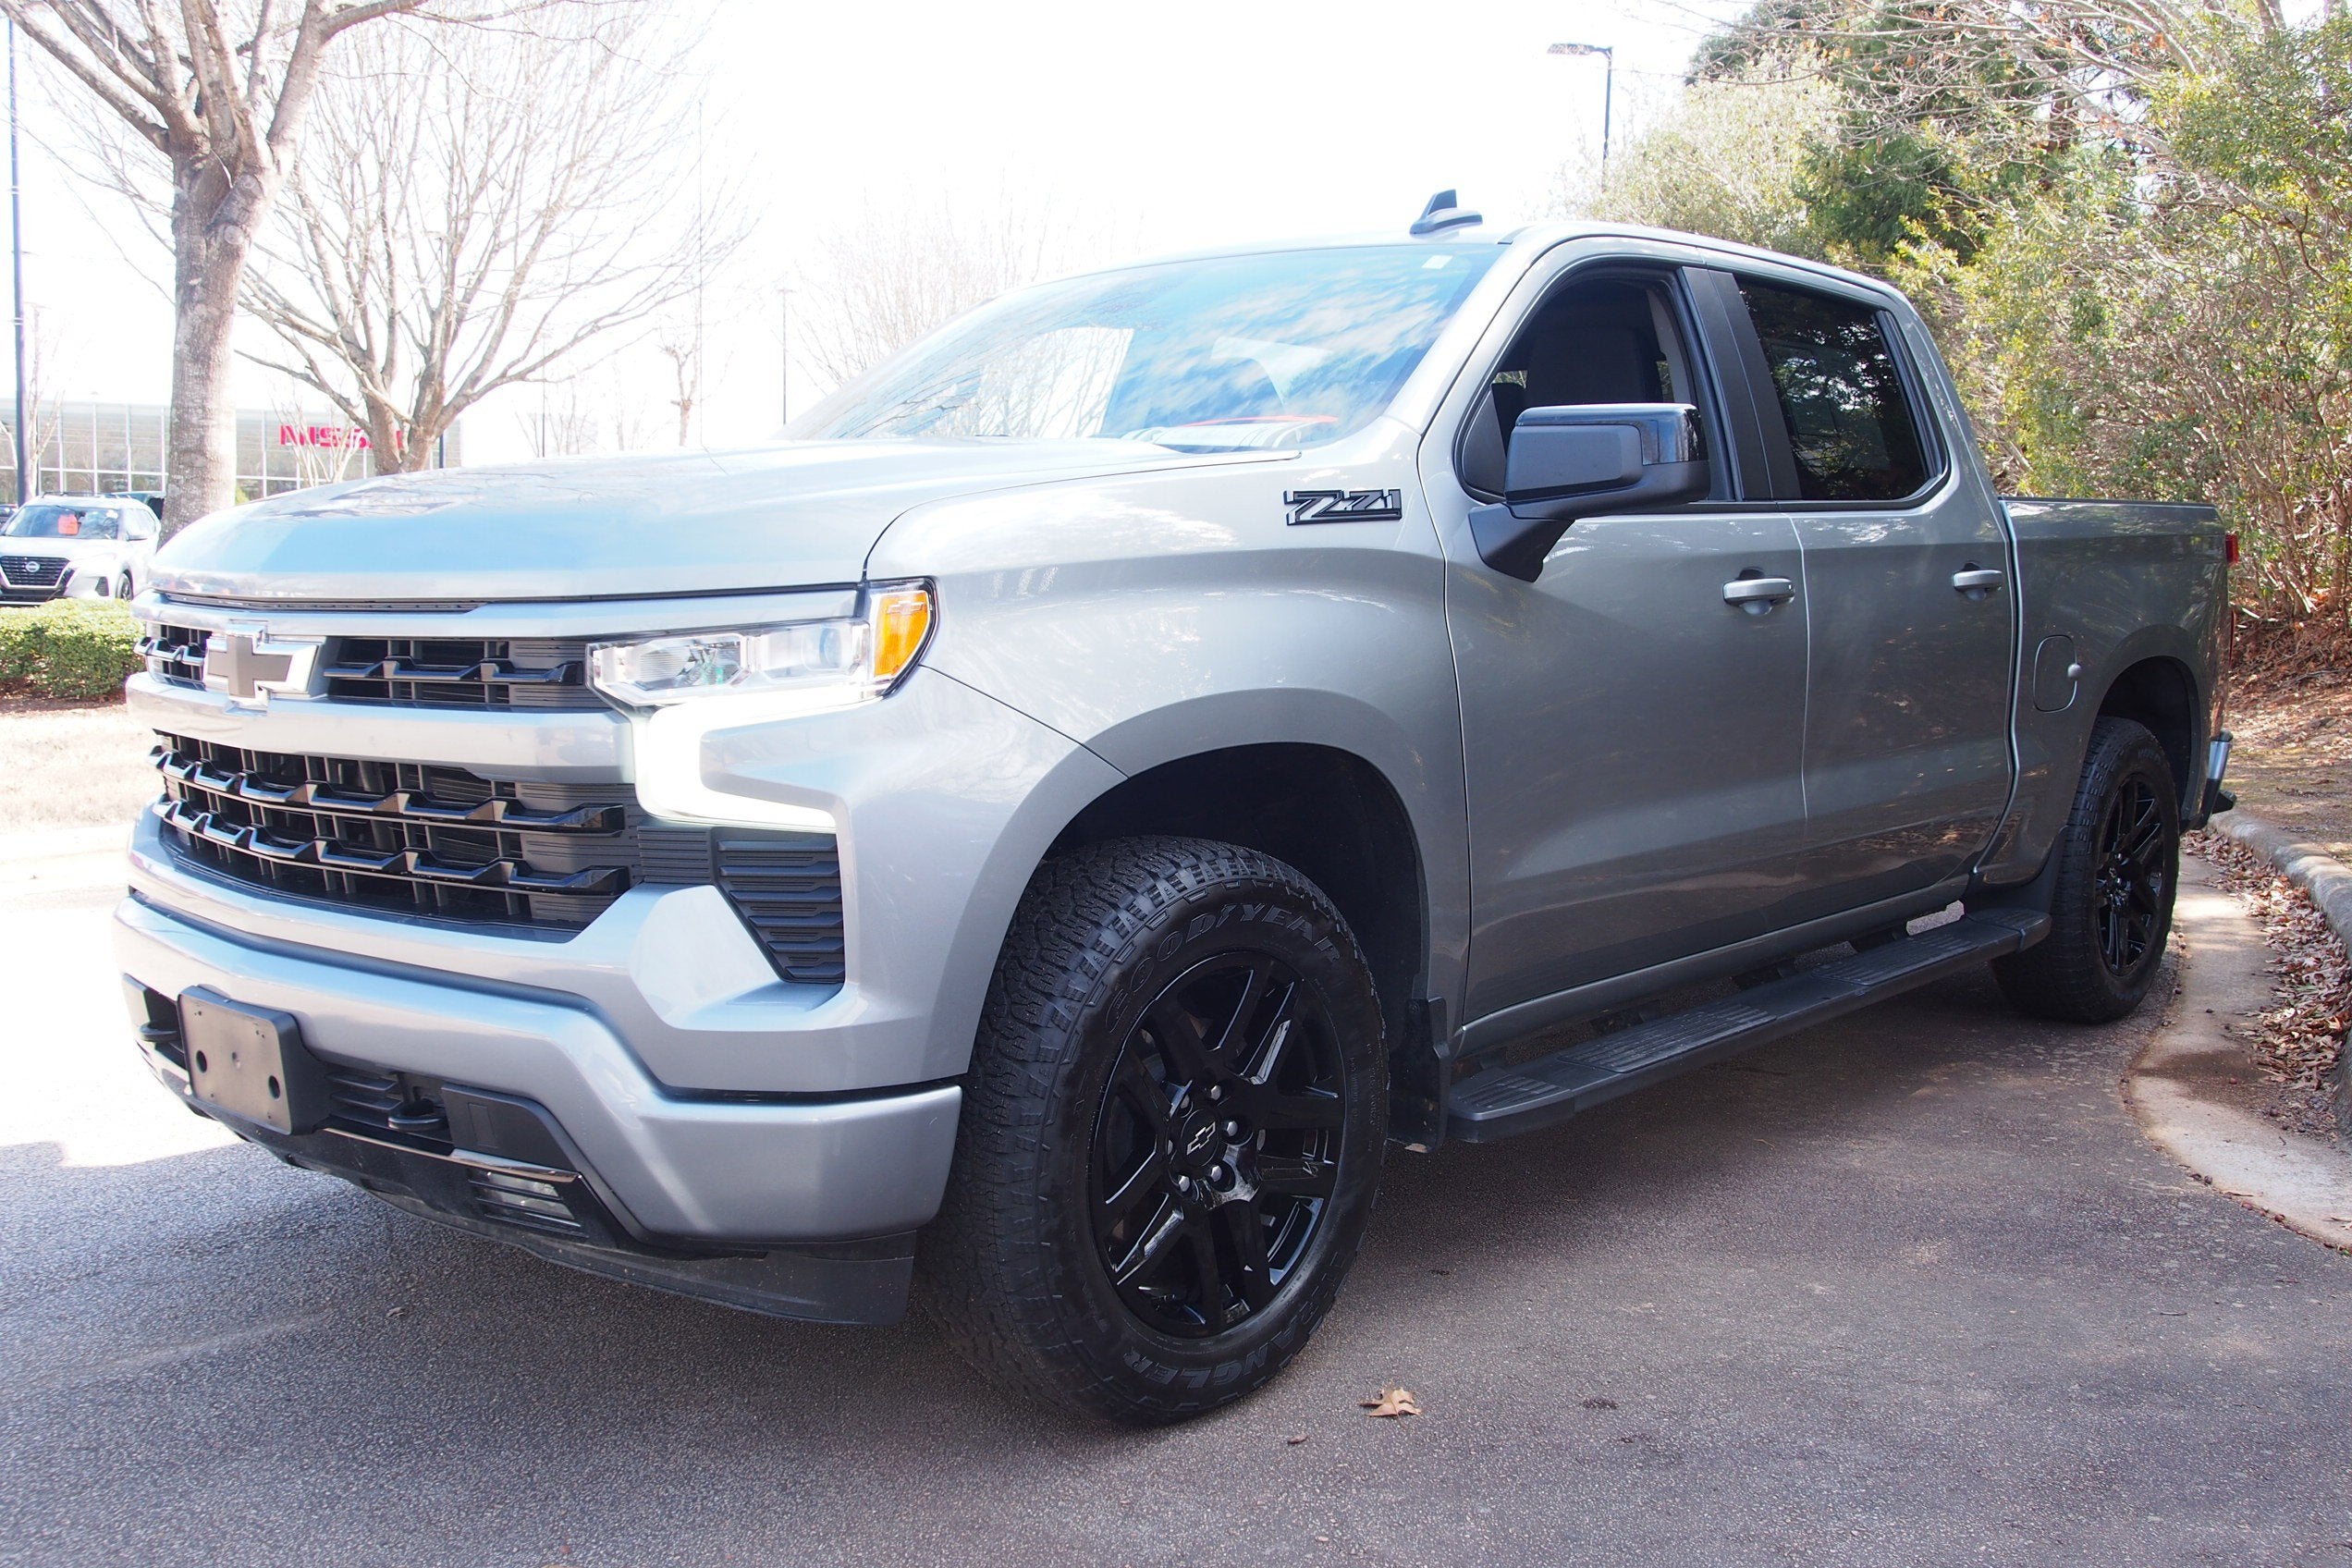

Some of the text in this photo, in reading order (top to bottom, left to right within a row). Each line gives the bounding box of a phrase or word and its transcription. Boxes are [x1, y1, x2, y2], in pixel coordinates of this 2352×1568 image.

[280, 424, 404, 449] NISS
[1283, 488, 1403, 525] Z71
[1105, 903, 1341, 1034] GOODYEAR
